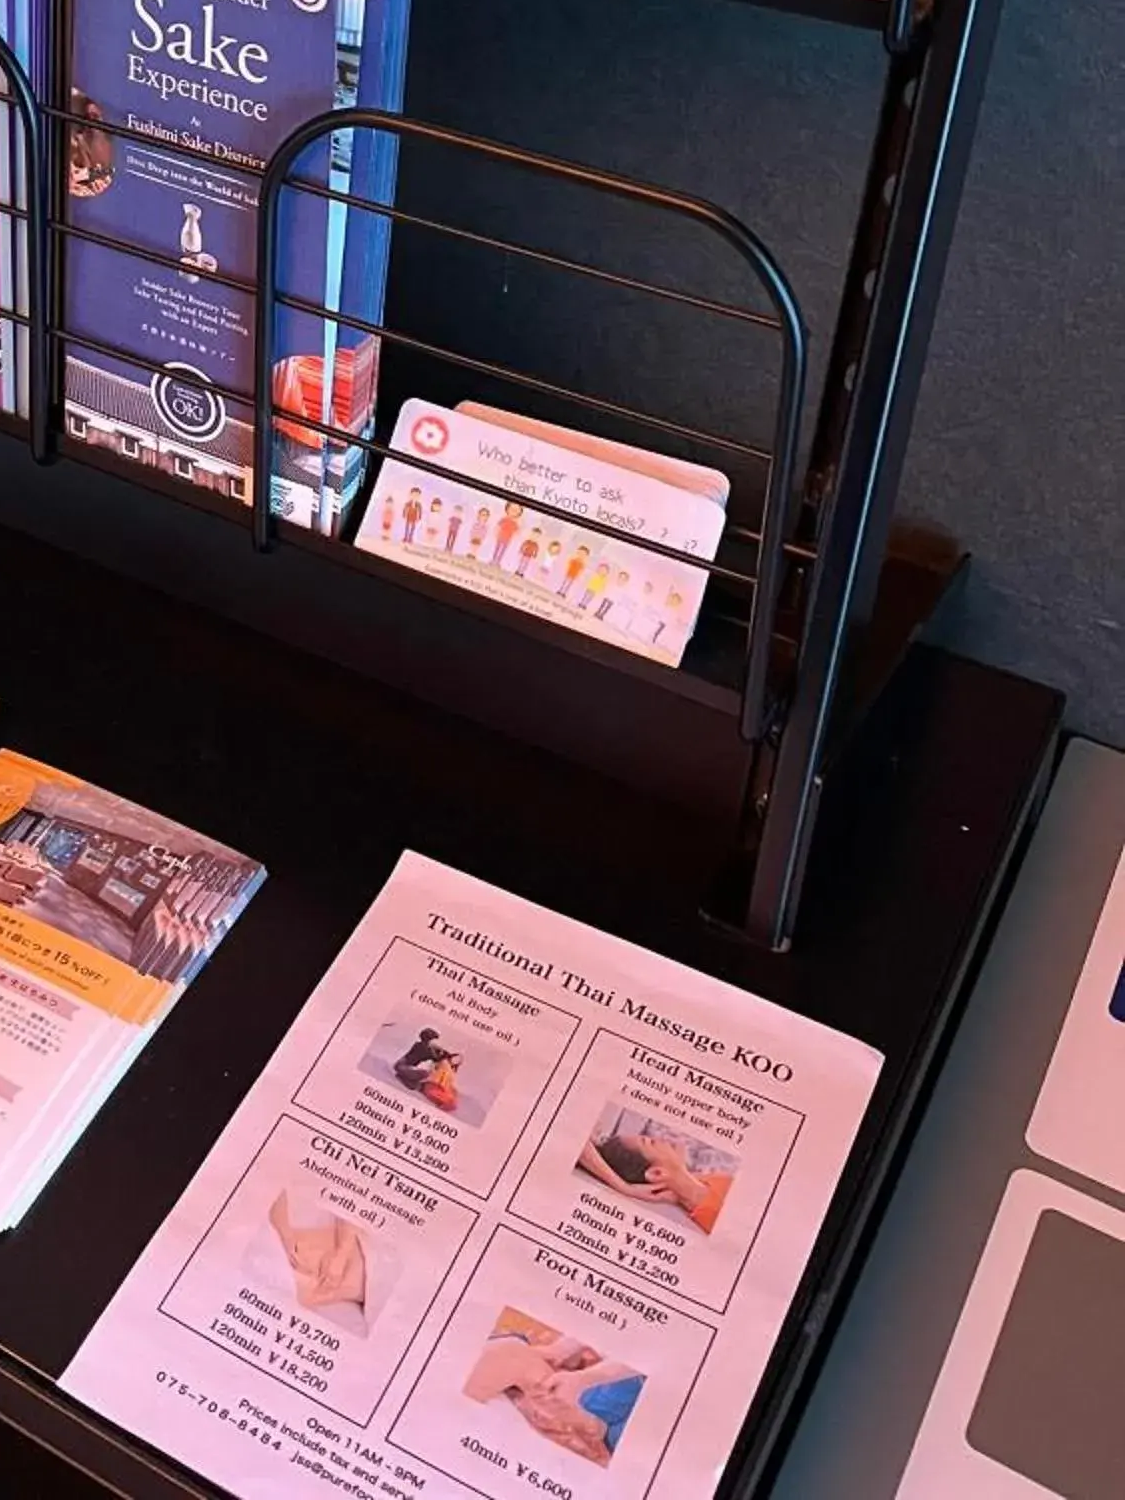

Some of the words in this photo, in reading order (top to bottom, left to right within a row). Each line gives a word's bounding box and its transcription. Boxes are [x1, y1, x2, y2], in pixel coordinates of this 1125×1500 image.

[127, 53, 268, 122] Experience
[127, 113, 178, 143] Fushimi
[180, 131, 213, 155] Sake
[214, 142, 266, 169] District
[189, 174, 203, 188] the
[205, 177, 233, 195] World
[182, 305, 196, 315] and
[173, 399, 204, 422] OK!
[477, 441, 513, 467] Who
[518, 455, 568, 483] better
[575, 474, 592, 493] to
[599, 484, 625, 504] ask
[503, 474, 536, 496] than
[542, 486, 588, 515] Kyoto
[53, 950, 69, 965] 15
[426, 956, 466, 983] Thai
[468, 976, 540, 1017] Massage
[428, 913, 554, 981] Traditional
[561, 970, 616, 1007] Thai
[619, 998, 726, 1054] Massage
[731, 1046, 794, 1082] KOO
[626, 1068, 671, 1095] Mainly
[629, 1047, 680, 1077] Head
[684, 1071, 765, 1114] Massage
[338, 1112, 387, 1143] 120min
[299, 1157, 369, 1197] Abdominal
[370, 1195, 426, 1227] massage
[311, 1136, 343, 1161] Chi
[346, 1154, 380, 1179] Nei
[384, 1171, 438, 1213] Tsang
[579, 1191, 625, 1222] 60min
[556, 1220, 610, 1256] 120min
[617, 1248, 680, 1287] ¥13,200
[571, 1208, 618, 1239] 90min
[625, 1233, 679, 1266] ¥9,900
[534, 1249, 577, 1282] Foot
[583, 1270, 668, 1326] Massage
[223, 1302, 269, 1337] 90min
[274, 1330, 335, 1373] ¥14,500
[238, 1288, 283, 1321] 60min
[288, 1312, 341, 1353] ¥9,700
[209, 1319, 262, 1357] 120min
[267, 1349, 328, 1394] ¥18,200
[238, 1398, 278, 1428] Prices
[280, 1423, 326, 1455] include
[306, 1417, 340, 1443] Open
[460, 1434, 509, 1469] 40min
